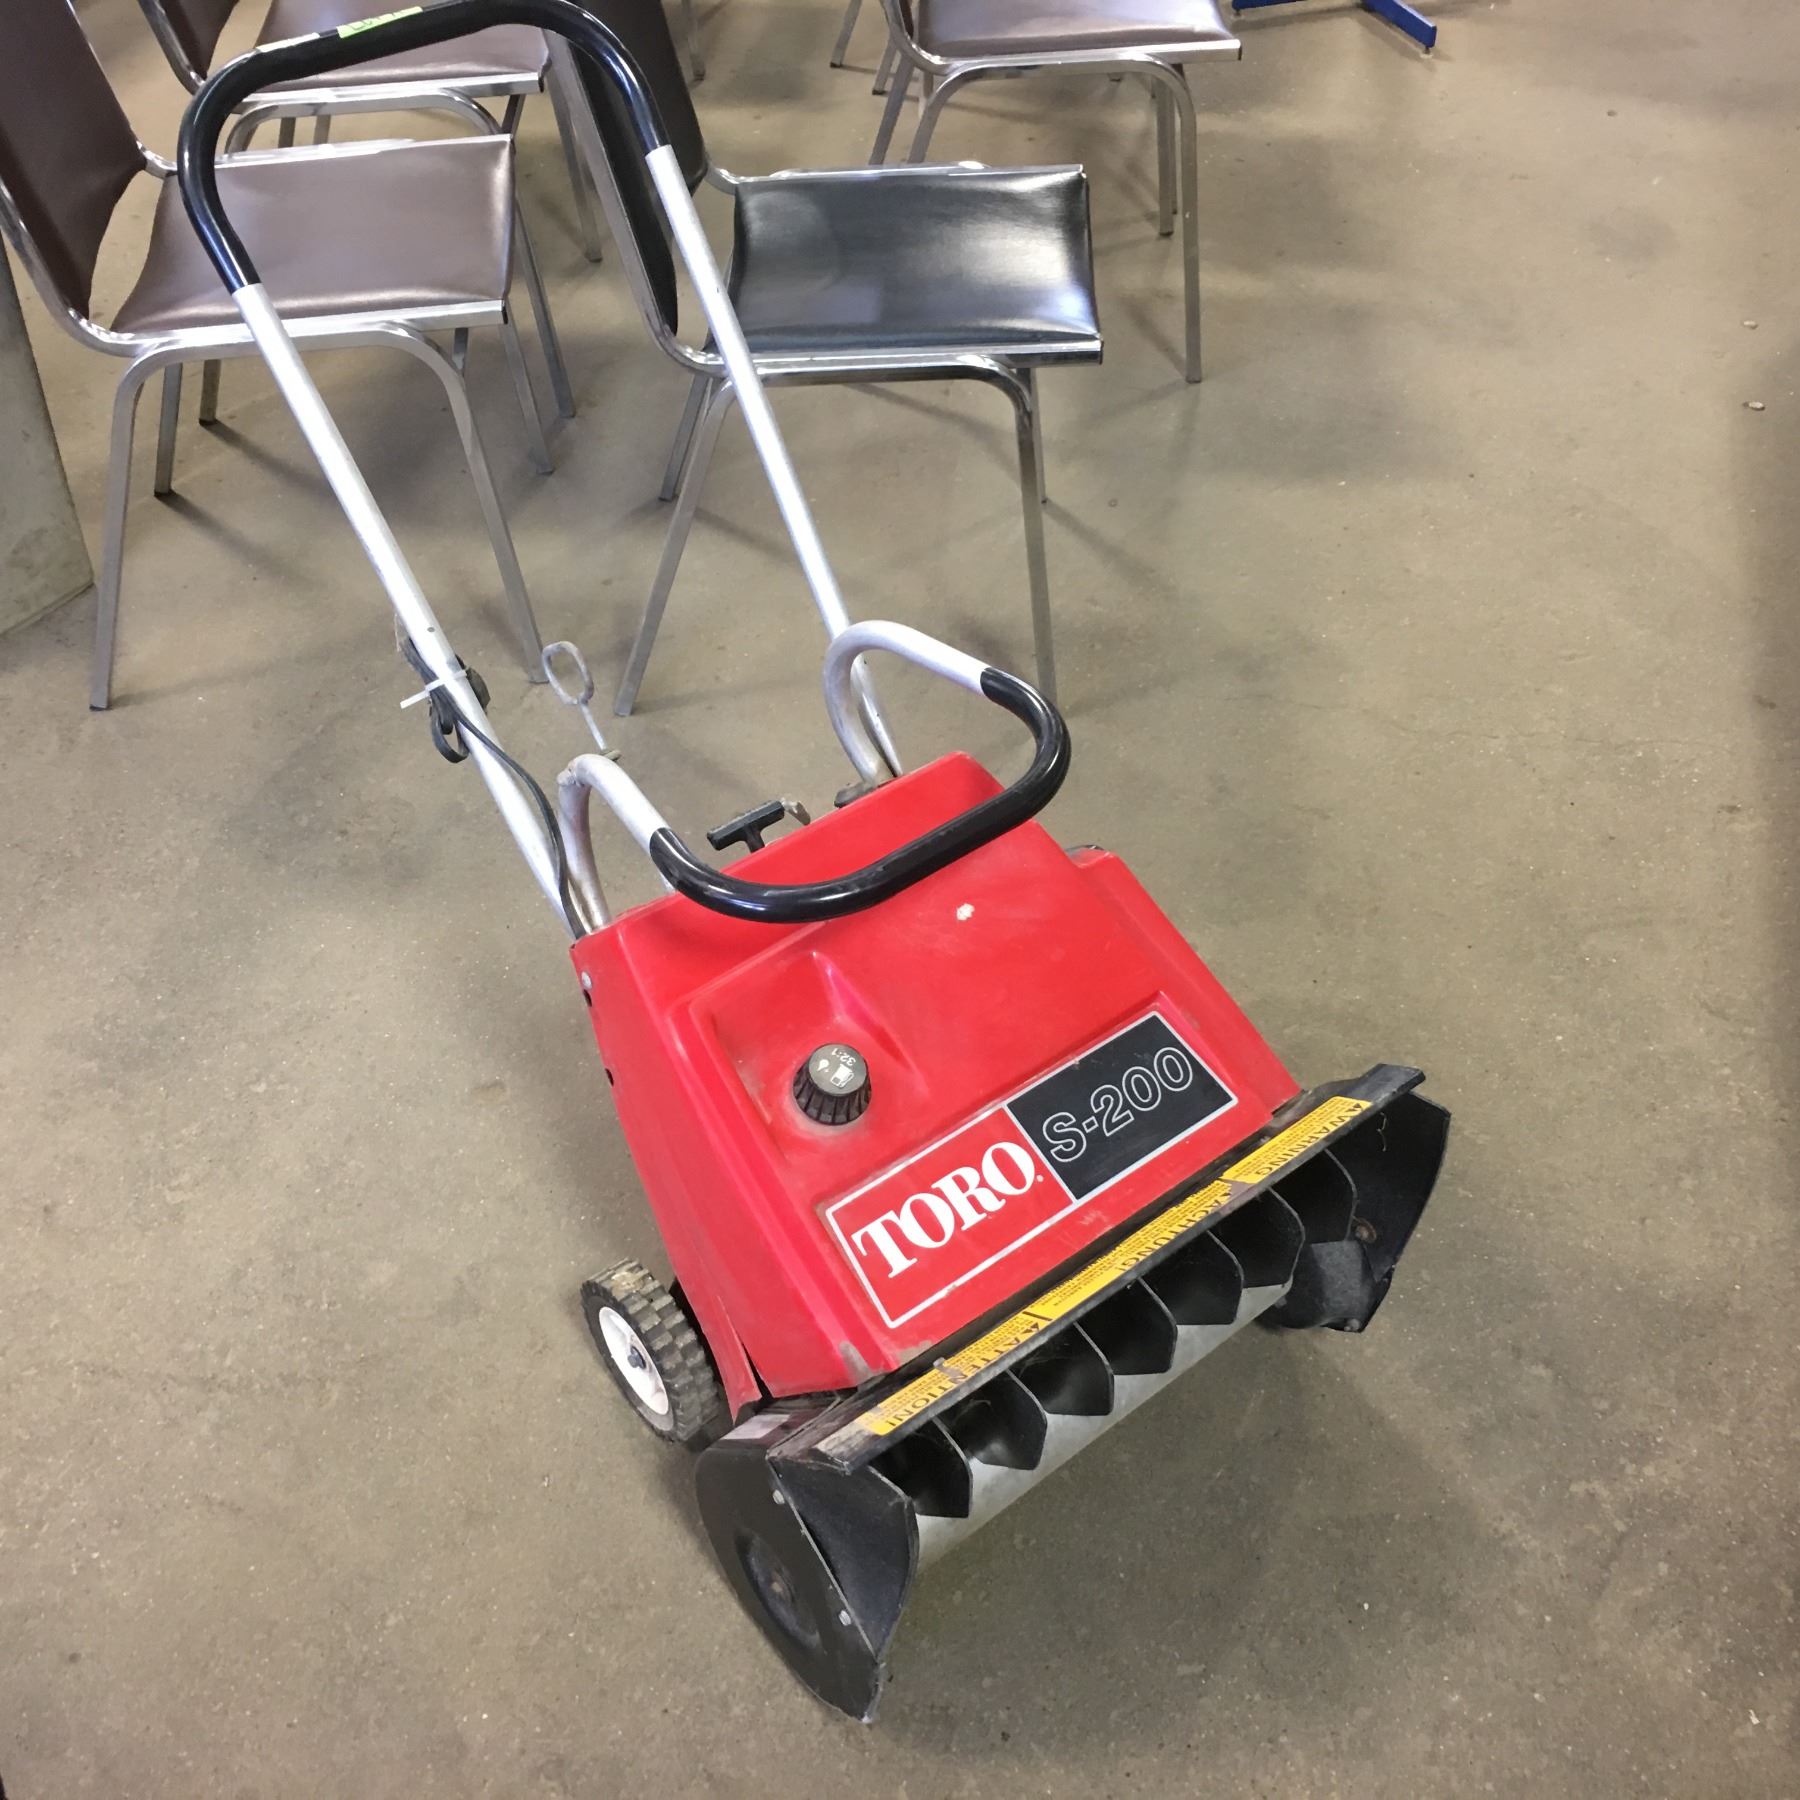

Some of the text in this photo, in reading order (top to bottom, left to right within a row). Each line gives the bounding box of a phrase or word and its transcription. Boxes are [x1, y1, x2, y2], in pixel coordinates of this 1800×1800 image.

[1042, 1046, 1194, 1163] S-200
[1255, 1115, 1351, 1176] WARNING
[851, 1141, 1035, 1278] TORO
